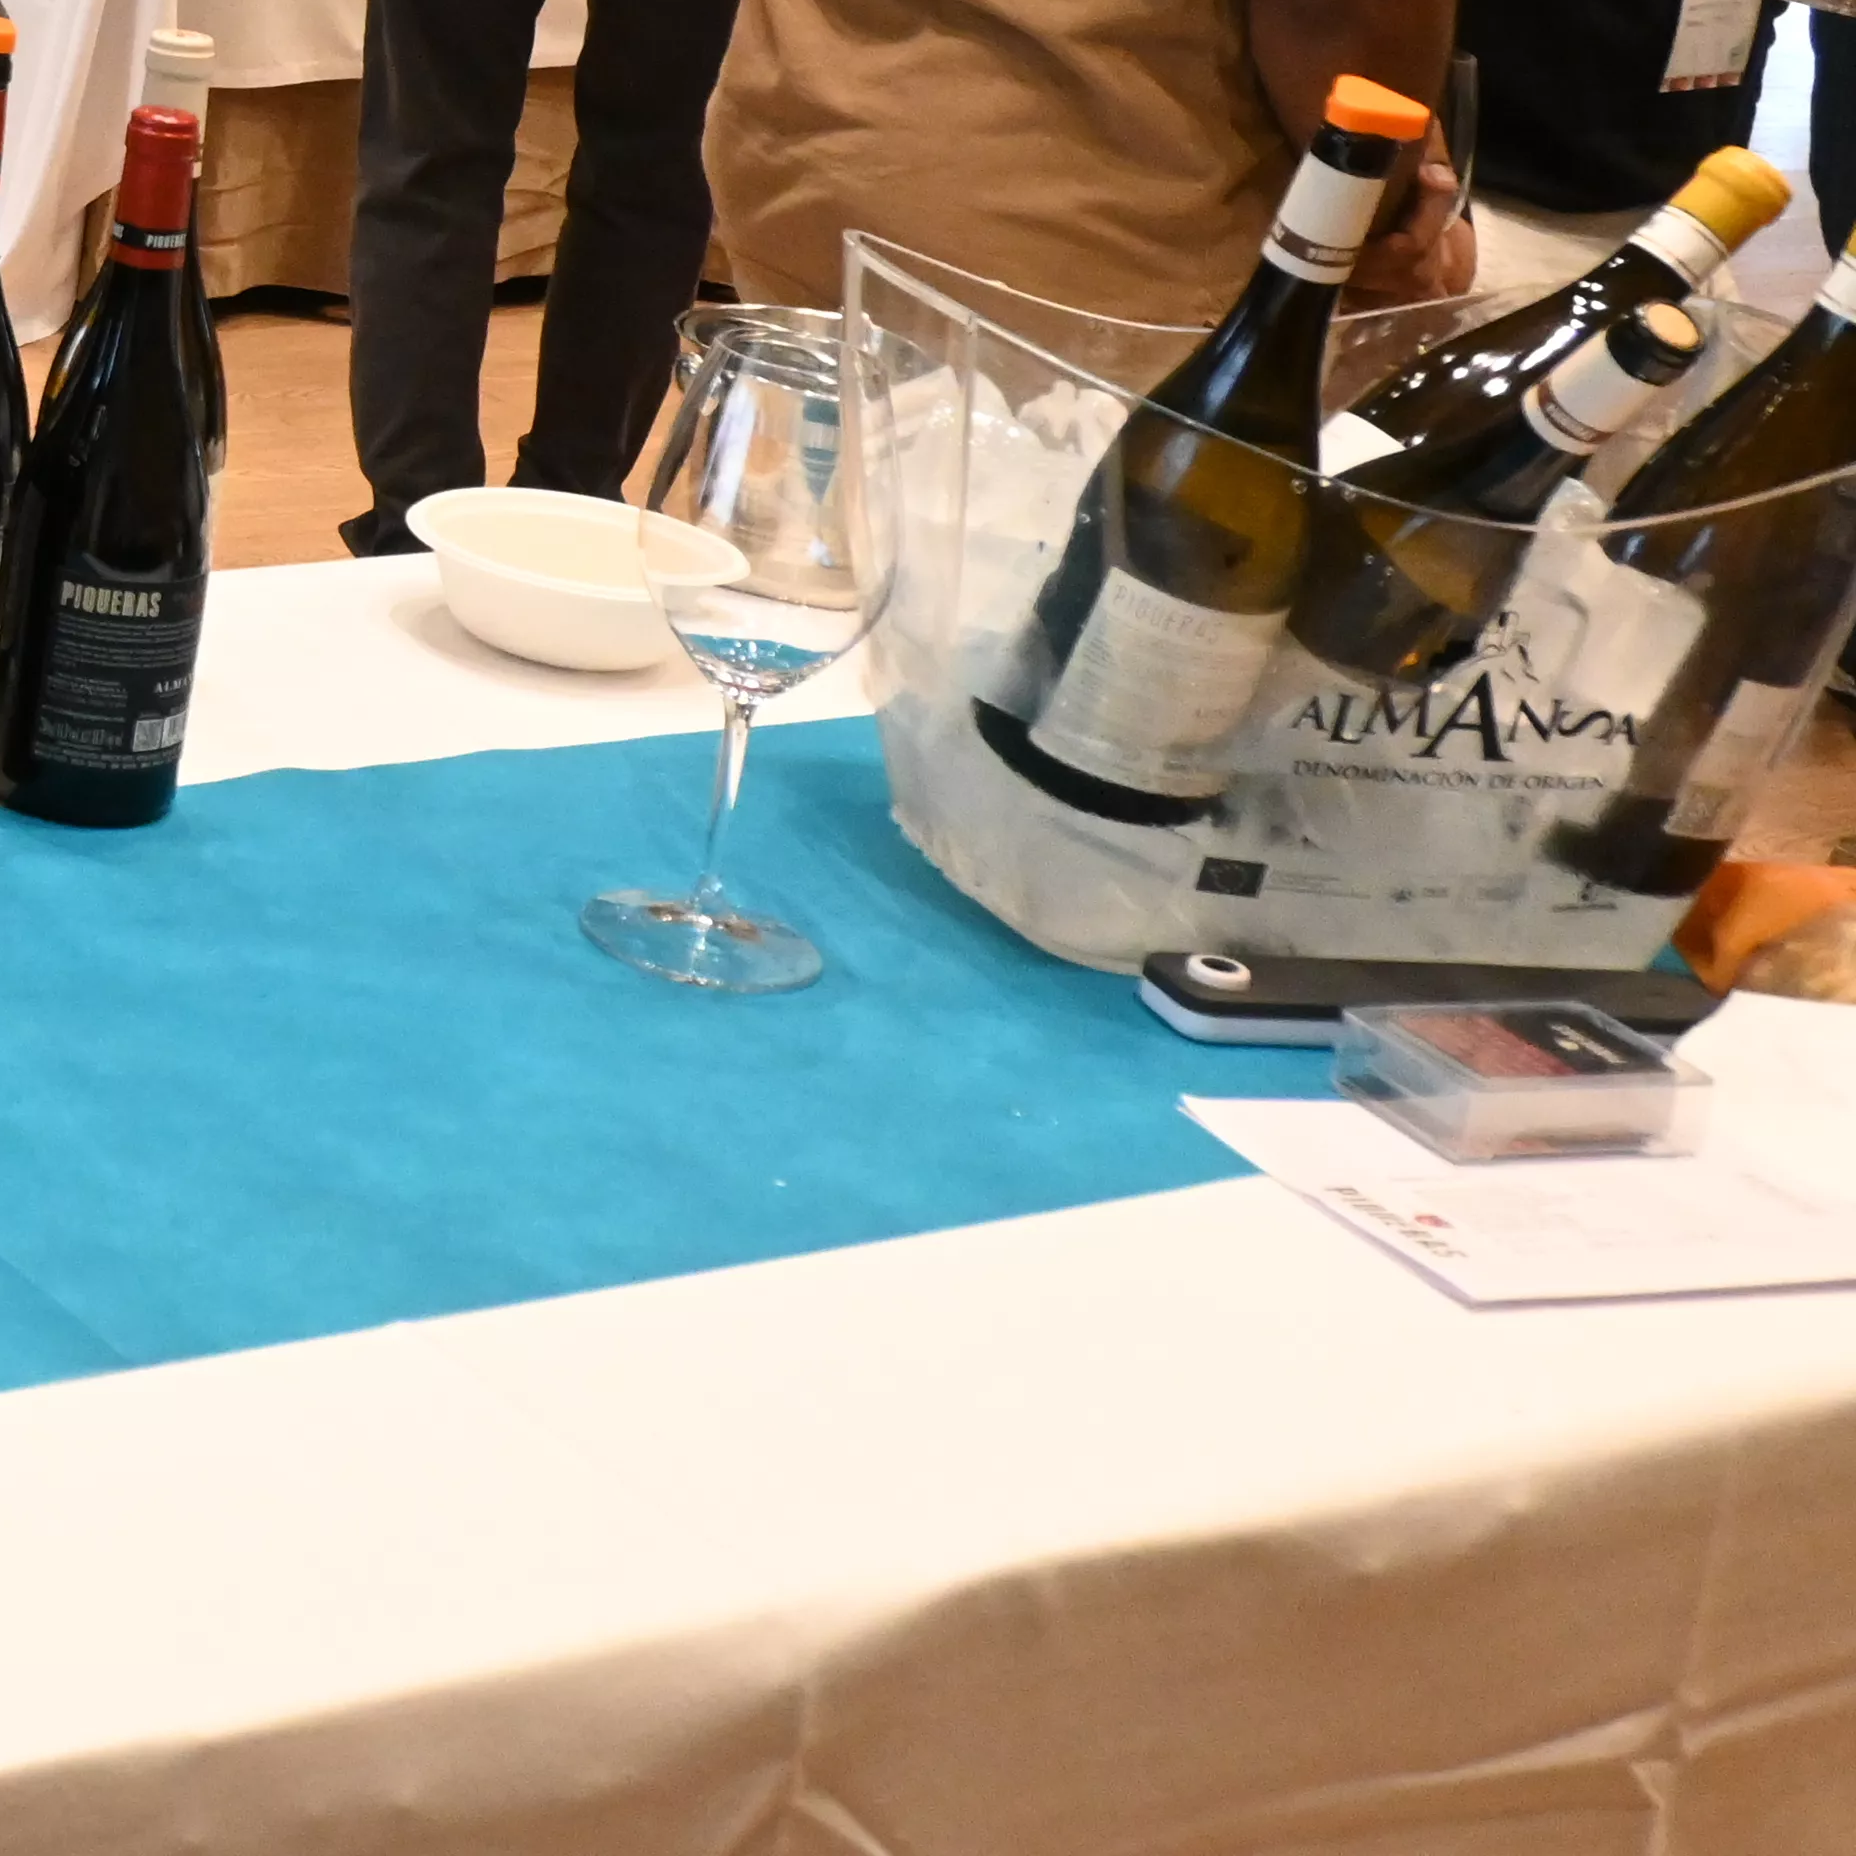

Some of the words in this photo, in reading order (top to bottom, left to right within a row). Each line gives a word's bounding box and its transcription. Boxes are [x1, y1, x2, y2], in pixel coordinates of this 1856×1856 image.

[61, 580, 163, 618] PIQUERAS
[1289, 668, 1641, 763] ALMANSA
[1293, 759, 1481, 789] DENOMINACIÓN
[1489, 773, 1516, 790] DE
[1523, 774, 1606, 791] ORIGEN
